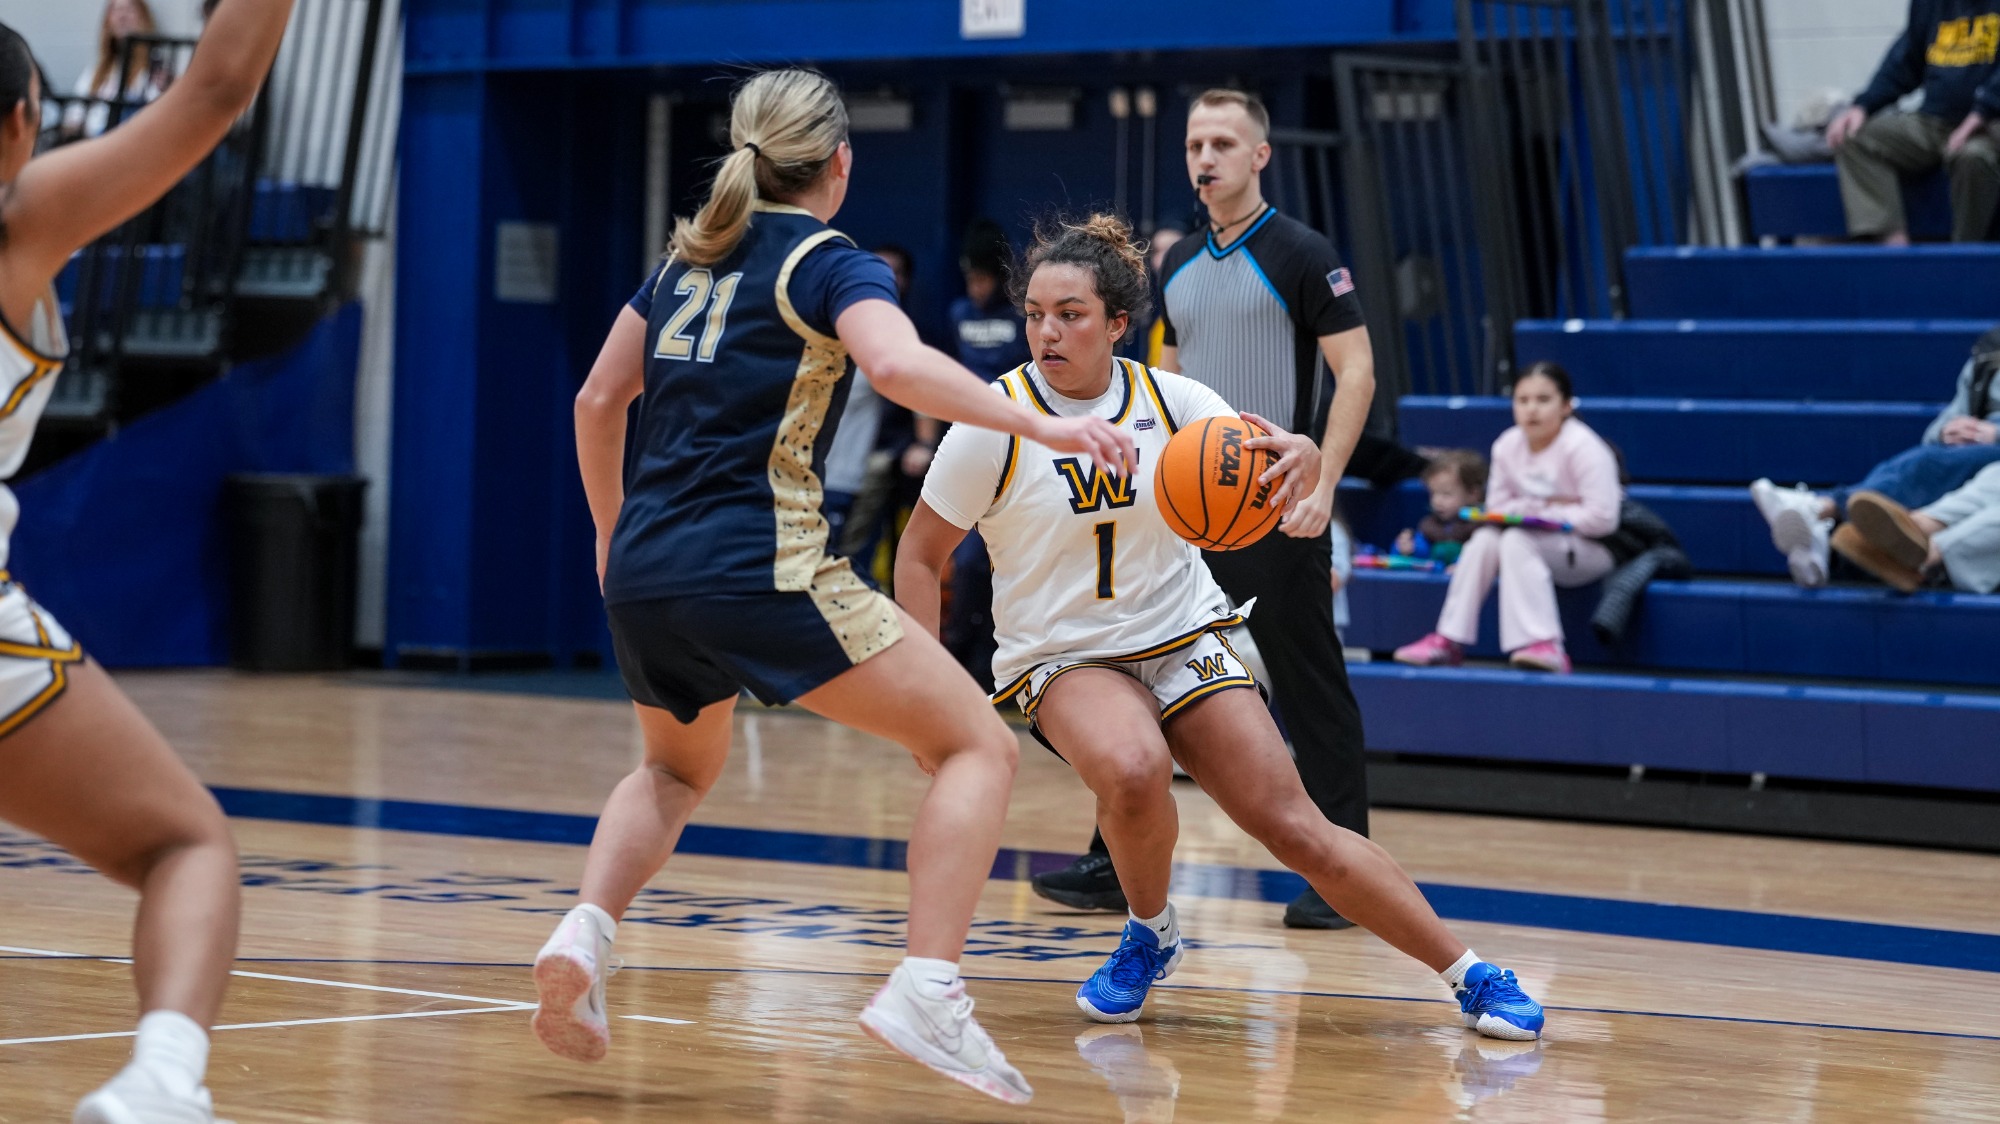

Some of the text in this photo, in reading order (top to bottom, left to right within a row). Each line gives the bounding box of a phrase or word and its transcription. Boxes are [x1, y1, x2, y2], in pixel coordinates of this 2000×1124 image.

[654, 268, 743, 363] 21
[1052, 447, 1140, 514] W
[1218, 427, 1242, 486] NCAA
[1093, 519, 1116, 599] 1
[1185, 653, 1228, 682] W
